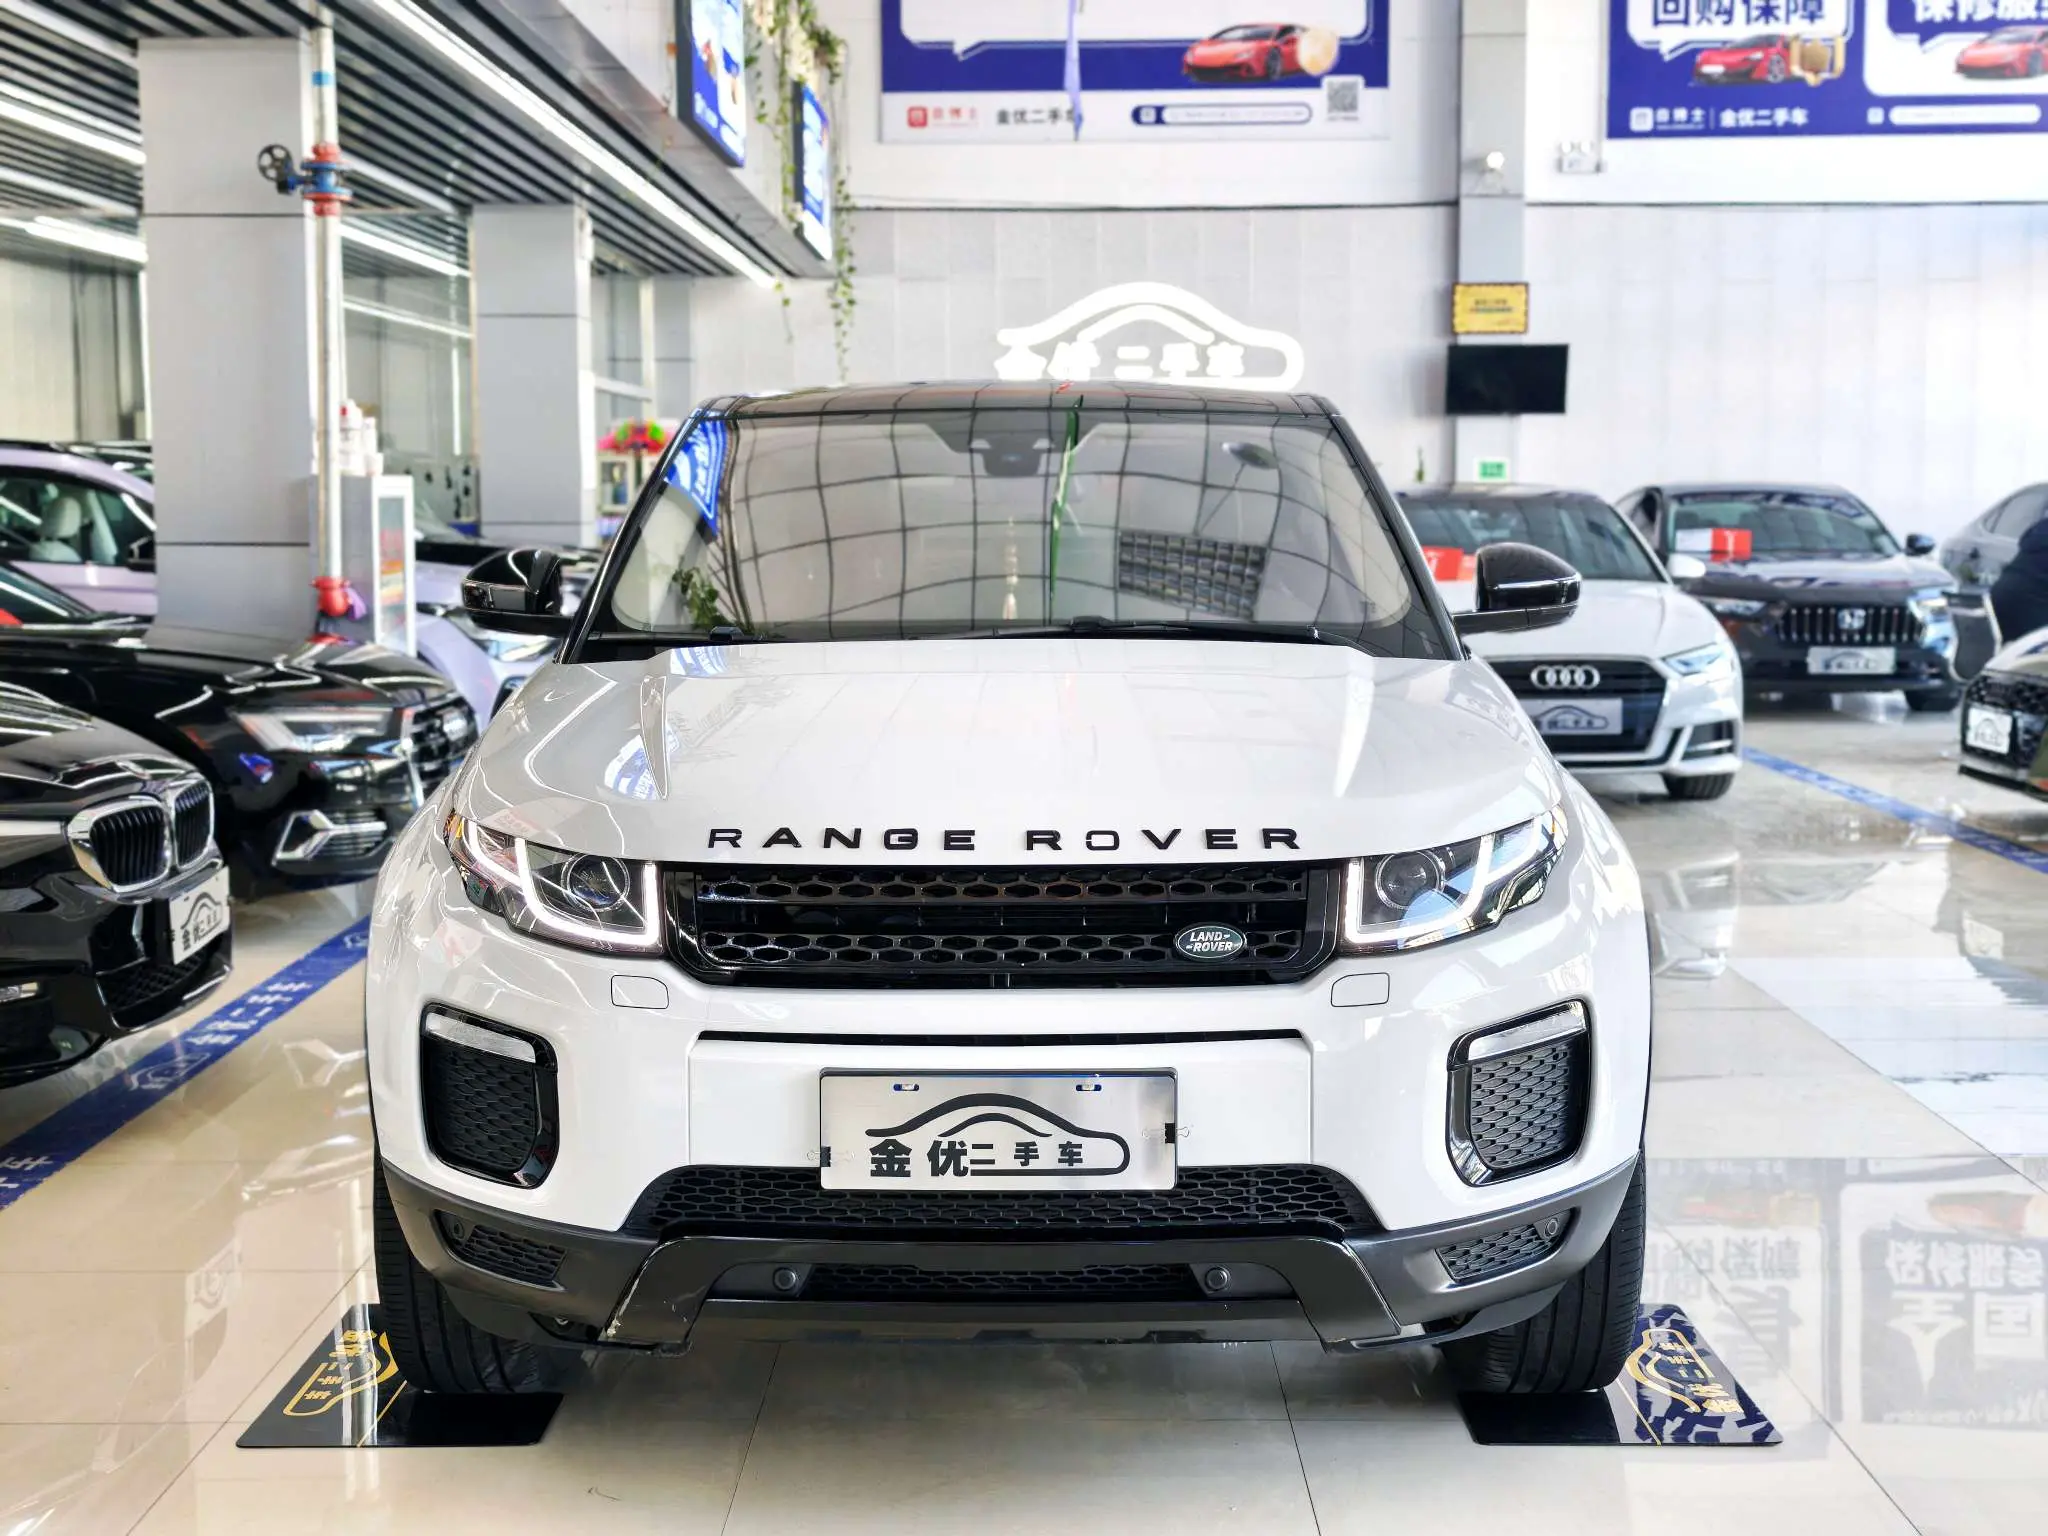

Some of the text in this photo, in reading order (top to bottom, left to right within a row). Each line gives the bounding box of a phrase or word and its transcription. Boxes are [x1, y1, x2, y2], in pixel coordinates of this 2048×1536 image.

[707, 828, 1301, 851] RANGE ROVER
[1189, 931, 1223, 942] LAND
[1193, 941, 1233, 952] ROVER
[869, 1139, 1084, 1178] 金优二手车
